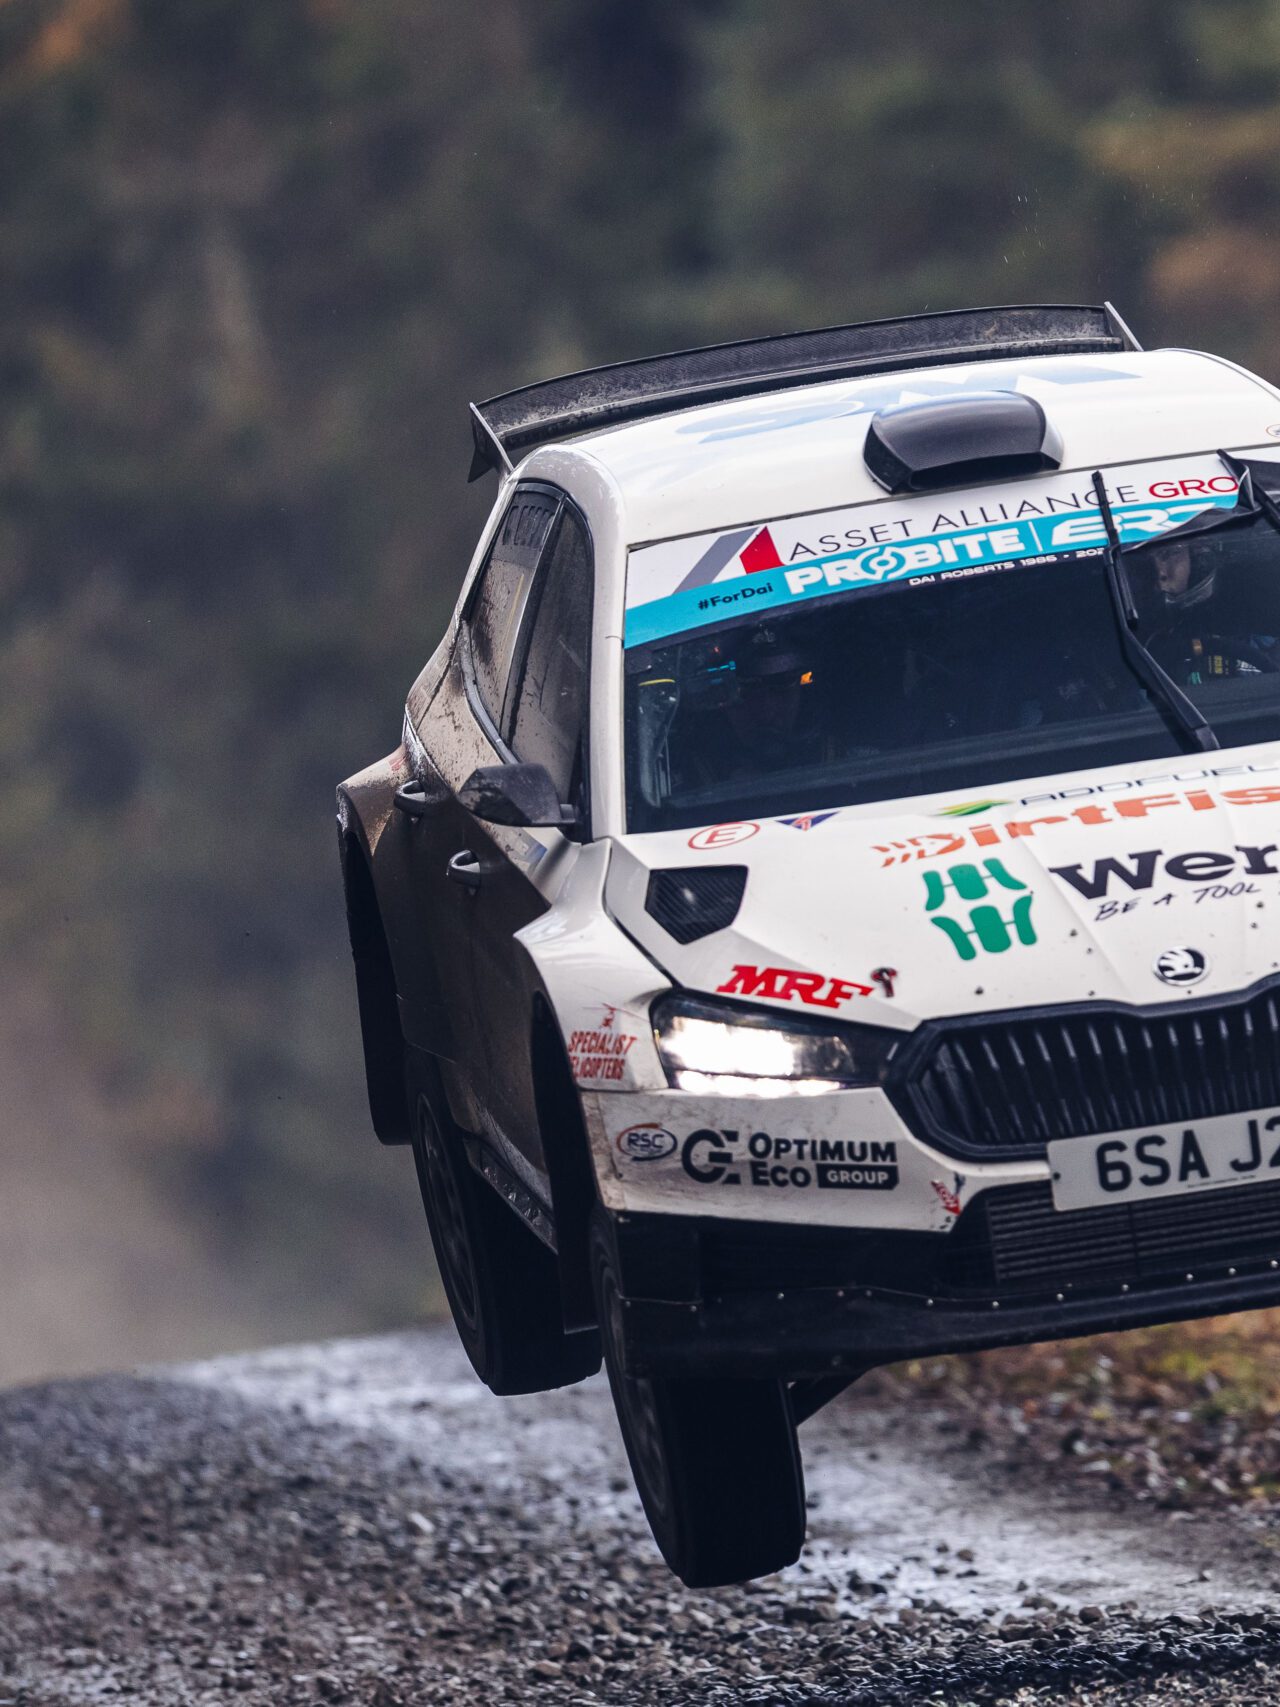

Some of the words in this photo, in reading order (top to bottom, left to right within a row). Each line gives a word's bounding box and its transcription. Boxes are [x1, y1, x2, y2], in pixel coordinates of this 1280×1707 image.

[789, 518, 913, 562] ASSET
[931, 485, 1140, 533] ALLIANCE
[1148, 476, 1239, 499] GRO
[784, 527, 1026, 595] PROBITE
[908, 574, 936, 587] DAI
[941, 560, 1016, 581] ROBERTS
[1019, 553, 1058, 567] 1986
[698, 582, 774, 611] #ForDai
[1094, 898, 1141, 922] BE
[1153, 893, 1177, 906] A
[1193, 882, 1263, 905] TOOL
[716, 964, 875, 1009] MRF
[568, 1030, 638, 1056] SPECIALIST
[569, 1055, 626, 1080] ELICOPTERS
[627, 1132, 665, 1149] RSC
[748, 1131, 898, 1163] OPTIMUM
[826, 1169, 890, 1184] GROUP
[1096, 1129, 1210, 1192] 6SA
